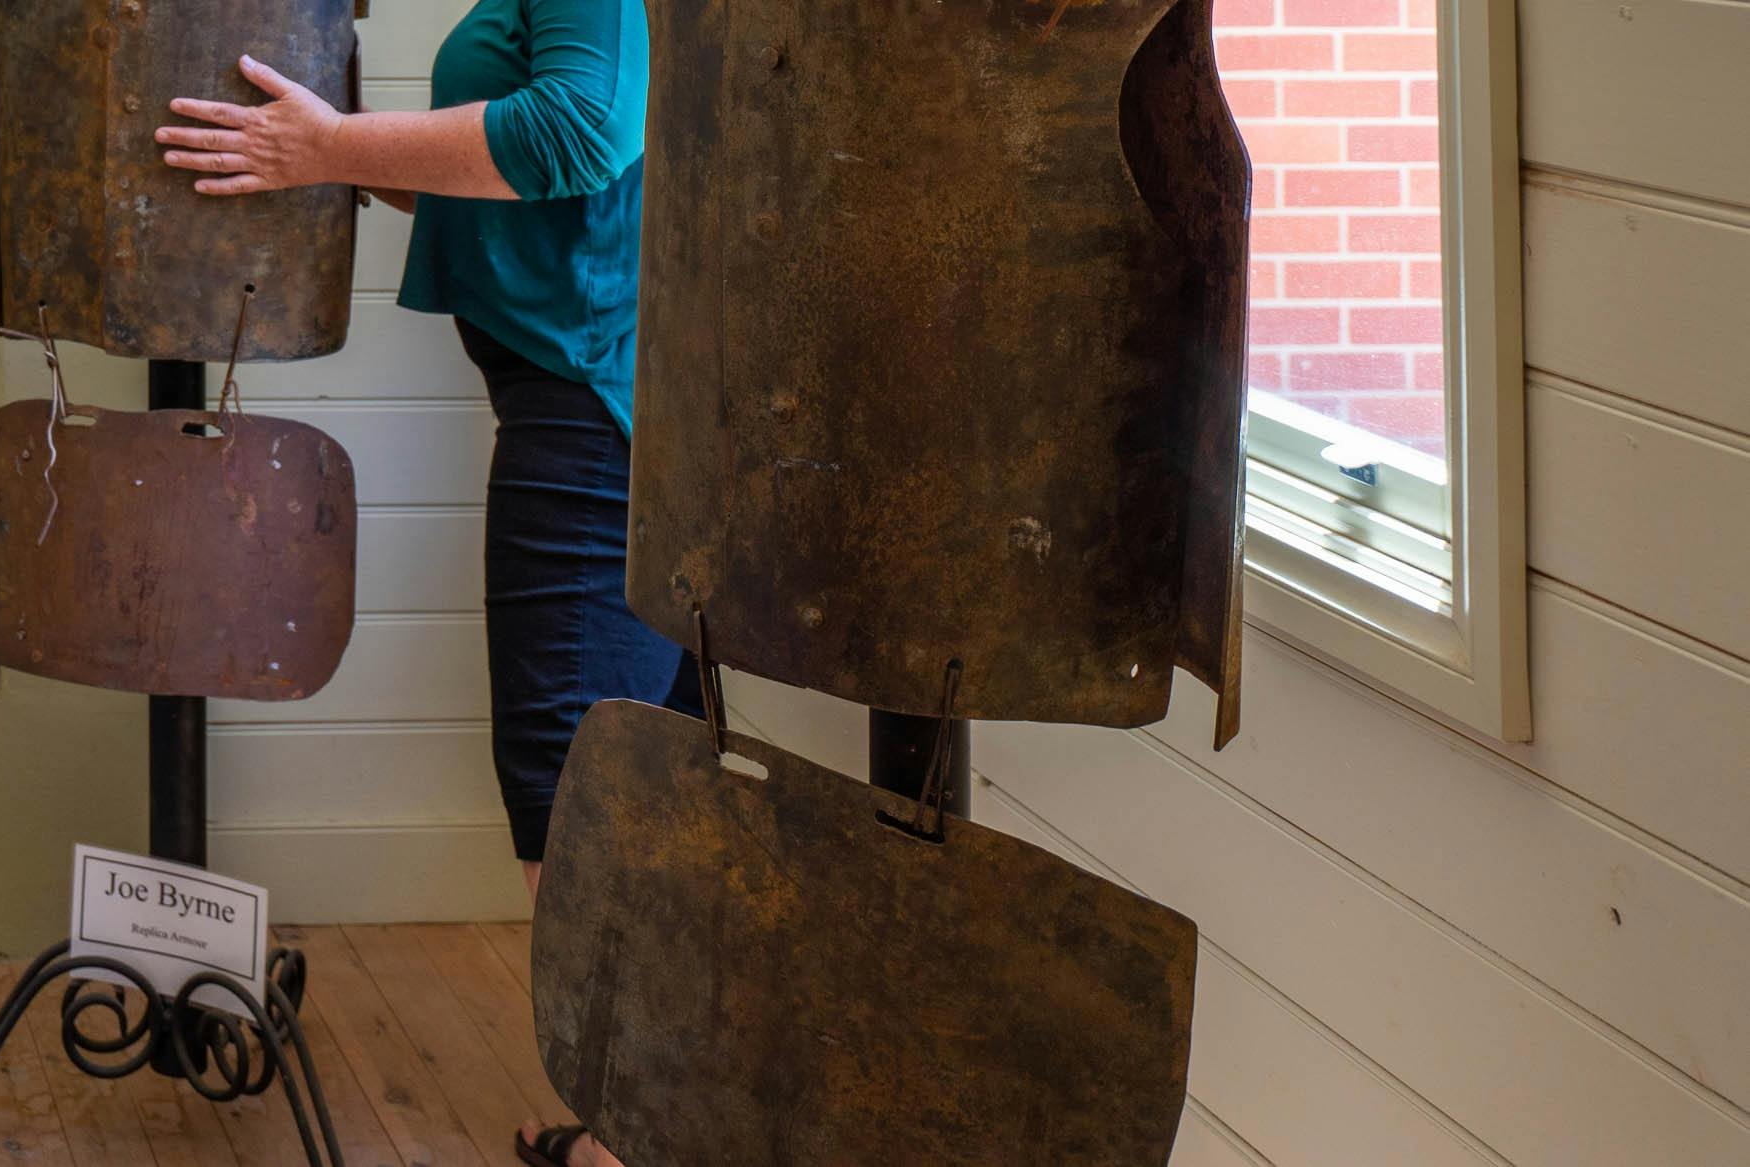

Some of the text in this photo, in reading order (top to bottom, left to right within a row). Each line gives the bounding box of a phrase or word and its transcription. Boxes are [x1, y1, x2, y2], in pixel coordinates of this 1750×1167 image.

[105, 872, 235, 923] Joe Byrne
[131, 923, 208, 950] Replica Armour
